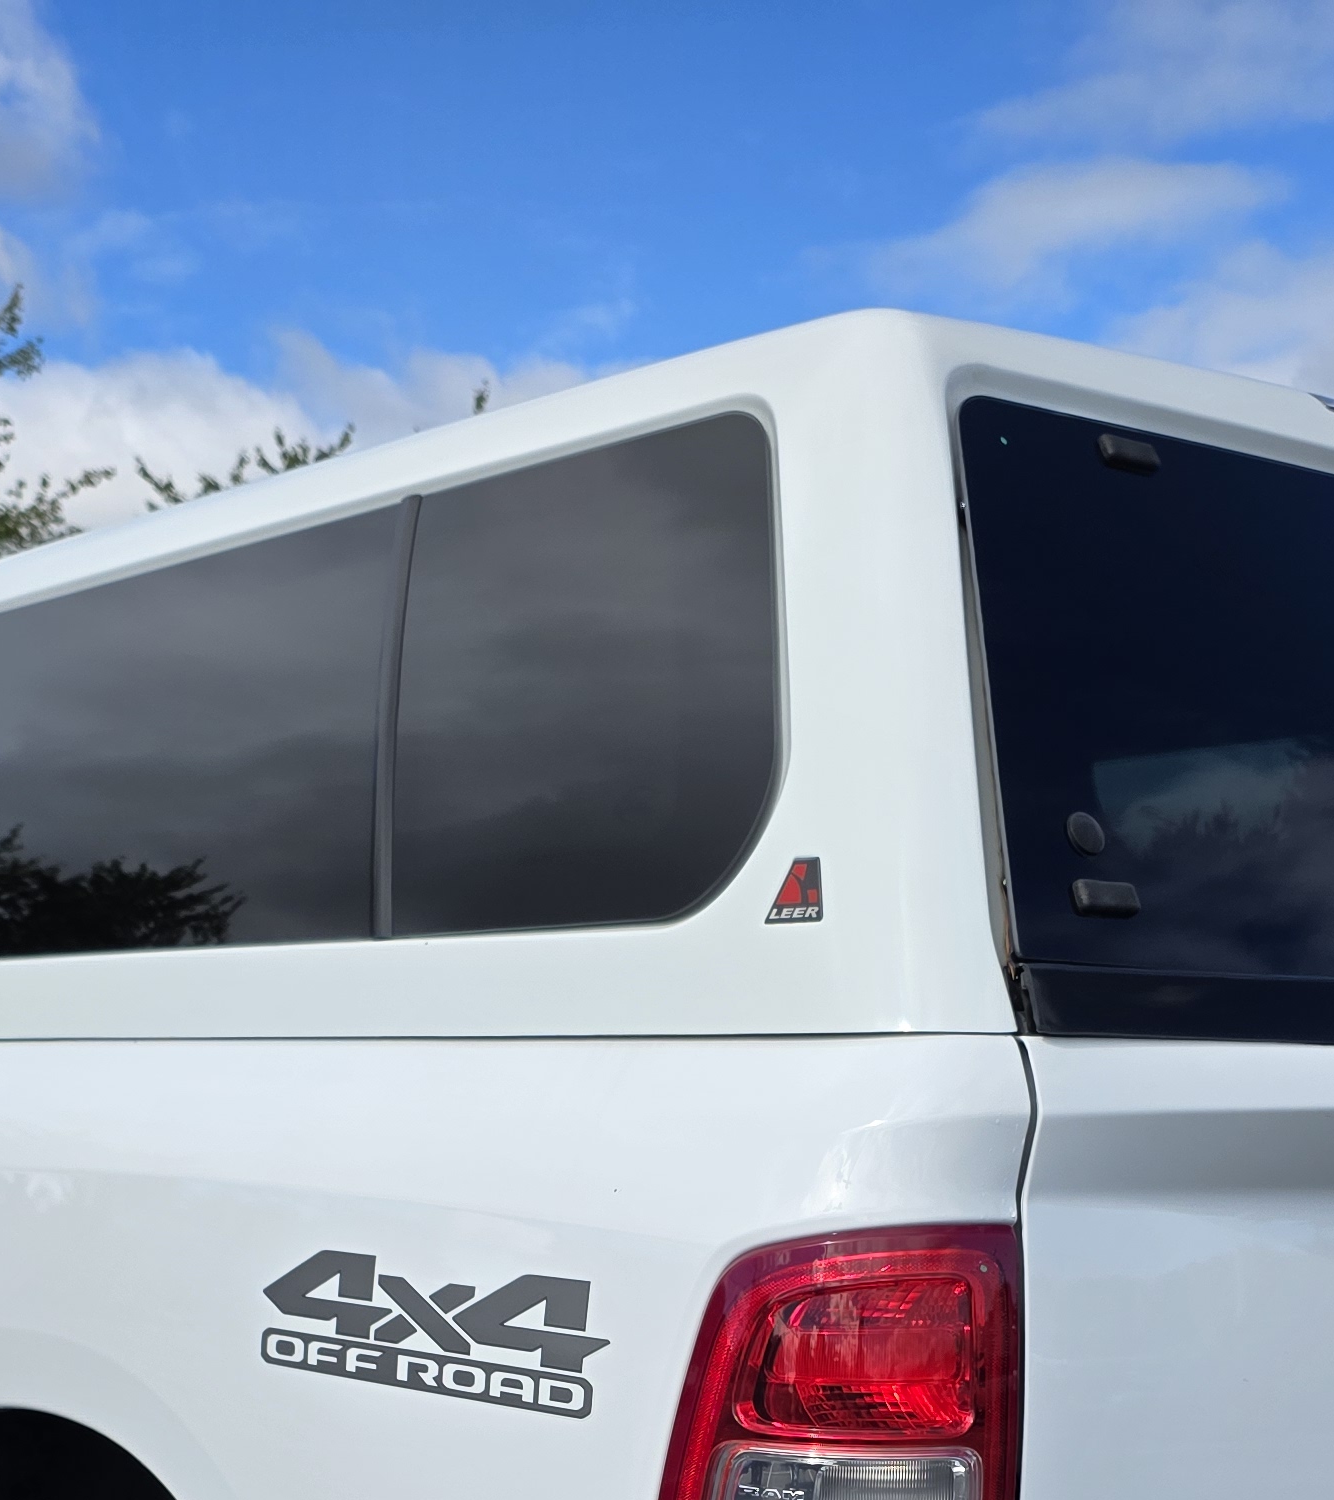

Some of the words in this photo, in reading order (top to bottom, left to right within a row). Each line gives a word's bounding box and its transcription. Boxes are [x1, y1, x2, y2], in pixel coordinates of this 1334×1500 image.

[769, 906, 820, 919] LEER
[267, 1334, 383, 1373] OFF
[396, 1354, 585, 1411] ROAD
[738, 1484, 805, 1500] RAM
